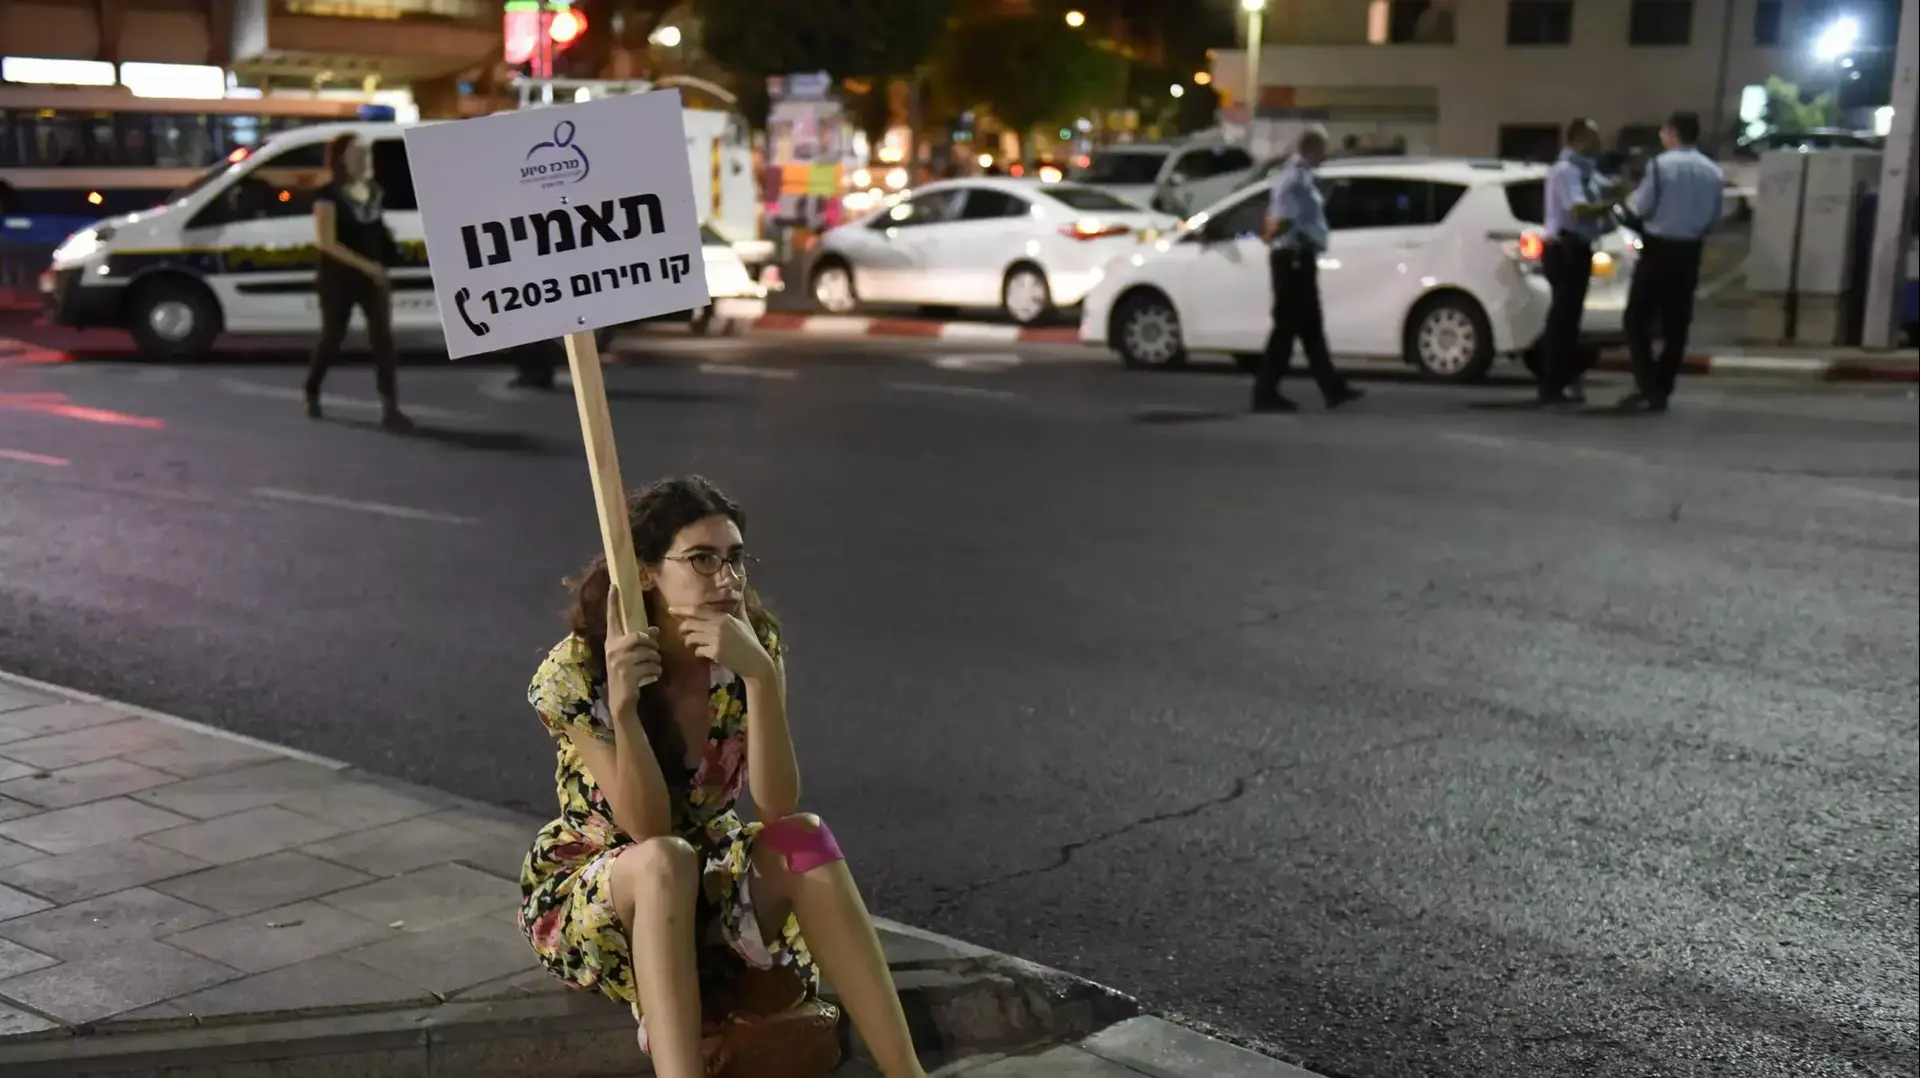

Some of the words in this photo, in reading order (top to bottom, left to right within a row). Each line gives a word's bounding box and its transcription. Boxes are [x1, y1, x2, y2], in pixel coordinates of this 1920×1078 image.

[520, 164, 547, 178] סיוע
[549, 159, 580, 172] מרכז
[461, 193, 666, 270] תאמינו
[570, 261, 652, 298] חירום
[660, 253, 691, 285] קו
[481, 278, 563, 315] 1203
